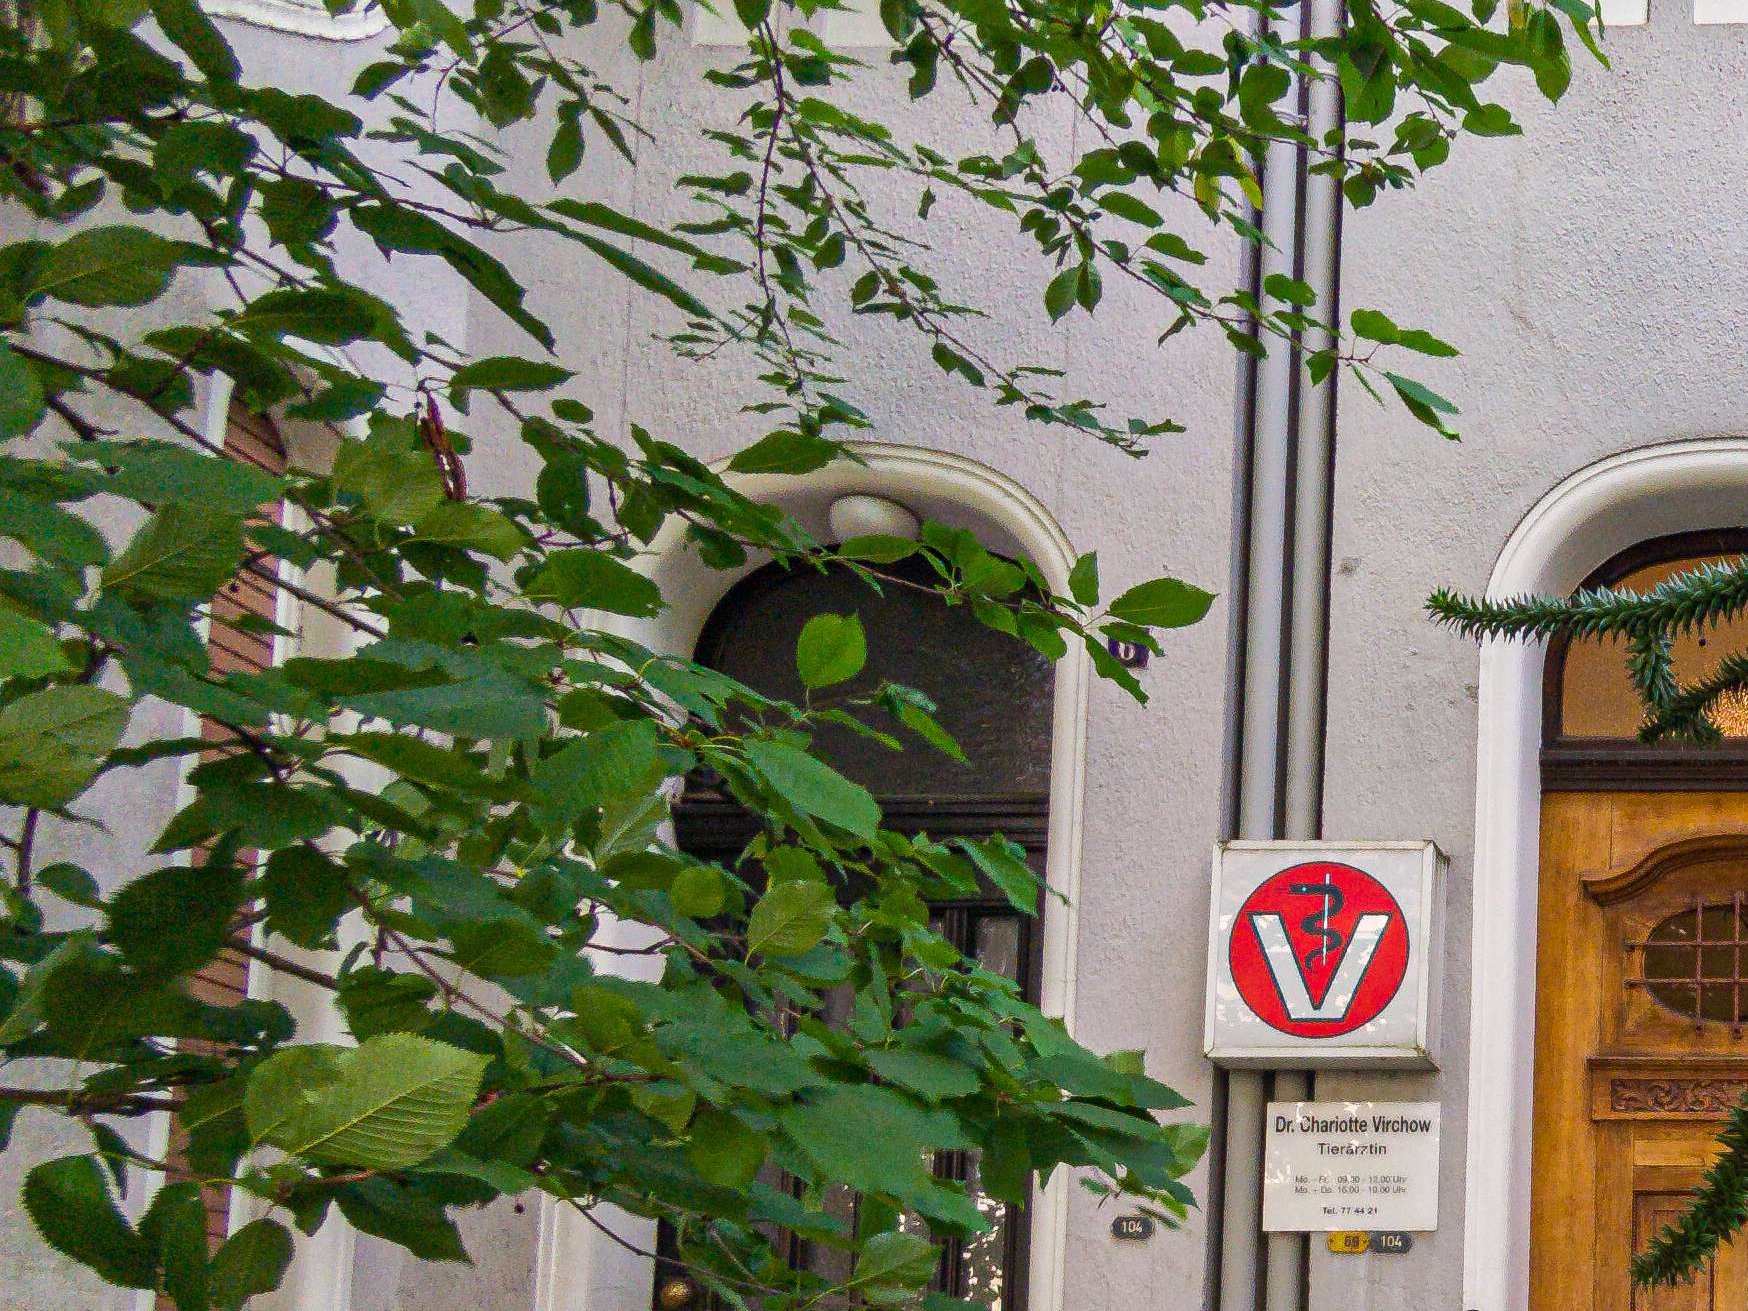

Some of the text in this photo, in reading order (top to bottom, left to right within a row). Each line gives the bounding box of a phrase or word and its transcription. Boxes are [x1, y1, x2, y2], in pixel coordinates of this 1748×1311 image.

[1247, 911, 1393, 1022] V
[1275, 1115, 1295, 1133] Dr.
[1372, 1115, 1432, 1133] Virchow
[1322, 1206, 1378, 1215] Tel. 77 44 21
[1121, 1220, 1143, 1233] 104
[1381, 1235, 1402, 1248] 104
